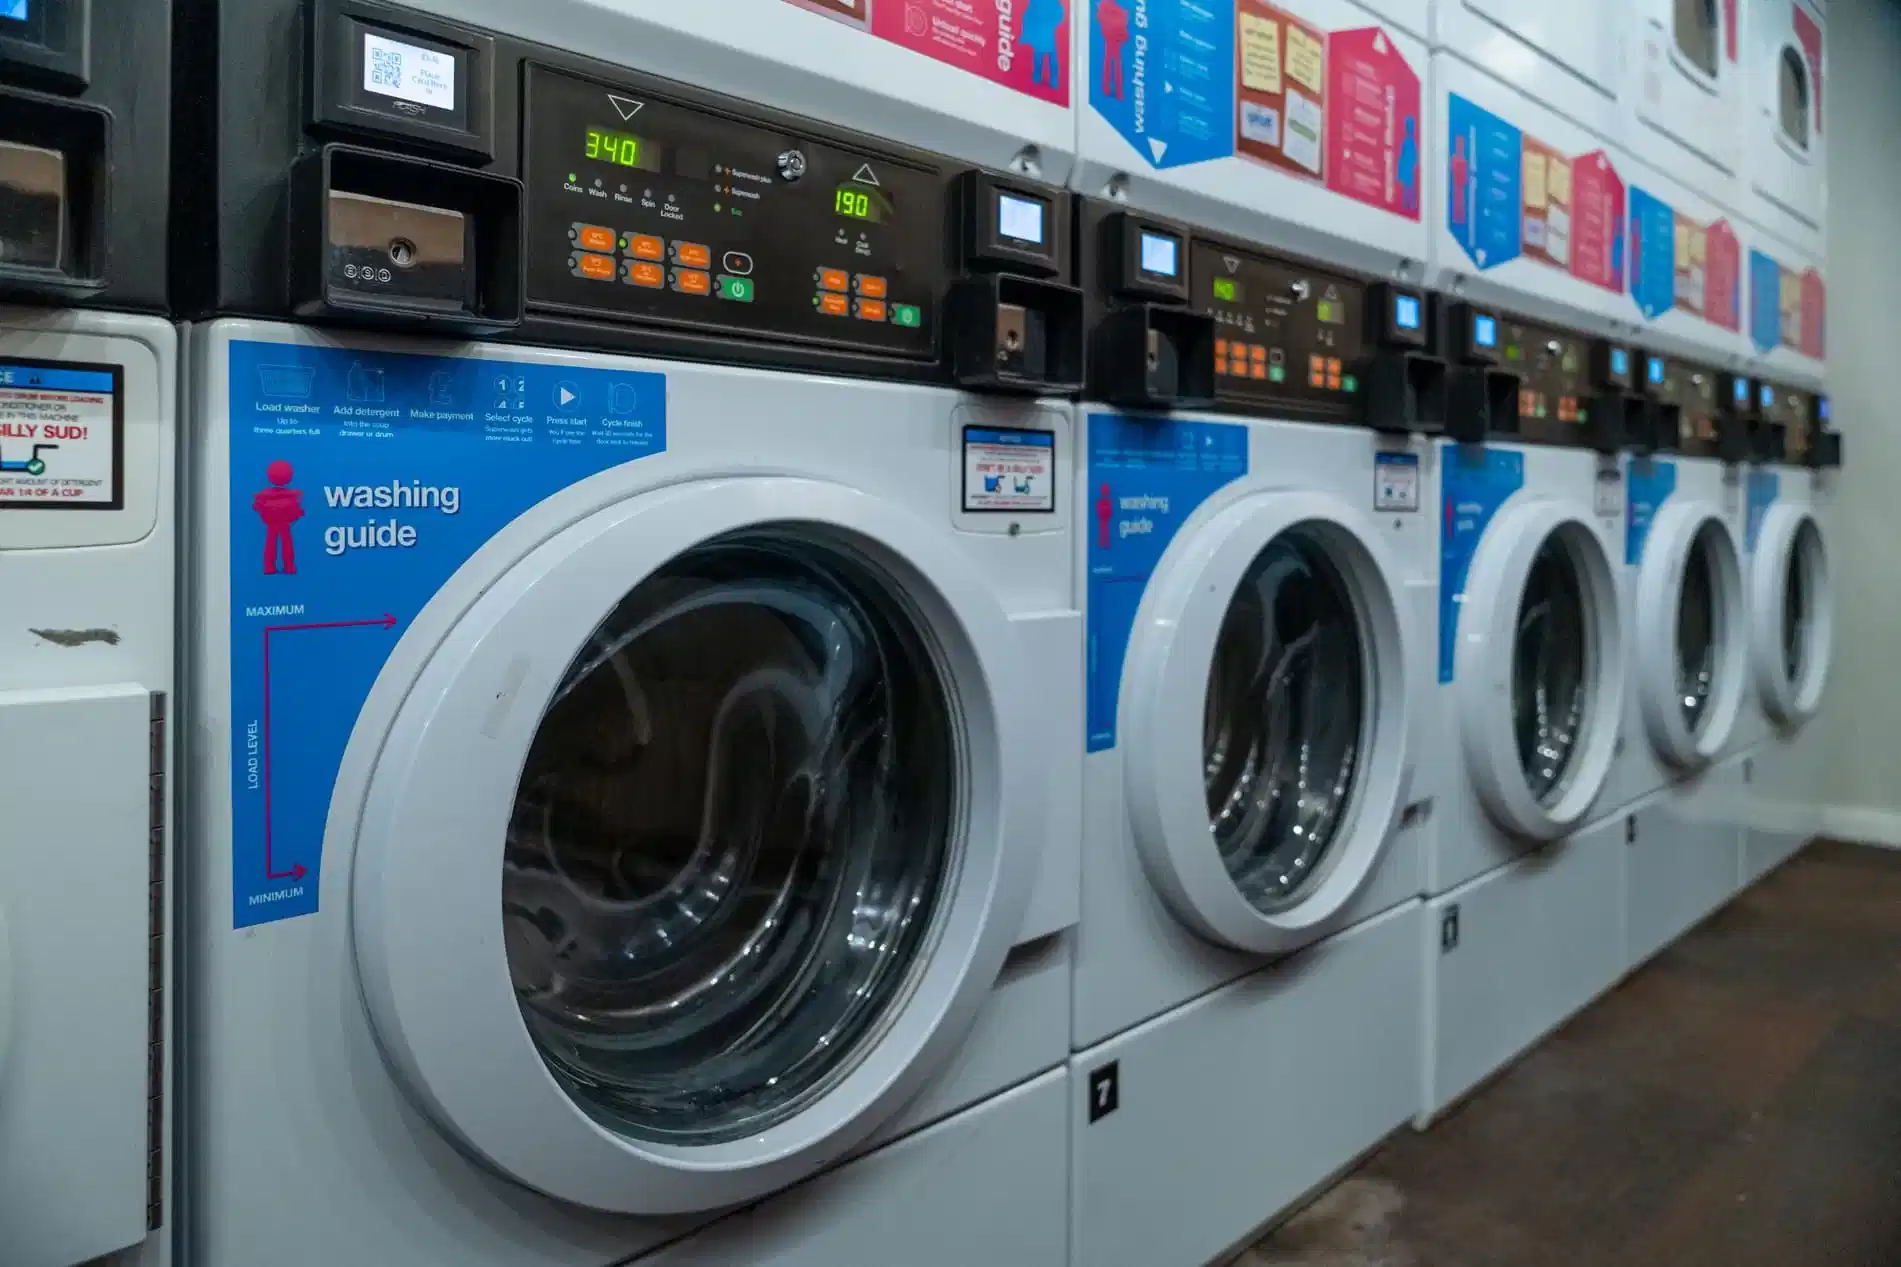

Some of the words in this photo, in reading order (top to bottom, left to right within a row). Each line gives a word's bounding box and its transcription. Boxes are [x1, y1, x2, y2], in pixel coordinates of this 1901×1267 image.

[994, 0, 1015, 72] guide
[1132, 35, 1148, 133] washing
[585, 131, 637, 166] 340
[563, 182, 584, 193] Coins
[588, 187, 608, 199] Wash
[614, 193, 633, 203] Rinse
[641, 198, 656, 209] Spin
[835, 190, 868, 217] 190
[664, 203, 680, 213] Door
[660, 210, 684, 221] Locked
[498, 379, 506, 391] 1
[255, 401, 282, 412] Load
[283, 403, 321, 414] washer
[333, 405, 353, 416] Add
[355, 407, 400, 419] detergent
[410, 408, 435, 419] Make
[436, 410, 474, 422] payment
[485, 412, 511, 423] Select
[512, 414, 533, 425] cycle
[546, 415, 569, 425] Press
[570, 416, 587, 426] start
[601, 417, 622, 428] Cycle
[623, 419, 644, 429] finish
[44, 425, 88, 440] SUD!
[375, 431, 394, 440] drum
[35, 488, 49, 497] OF
[51, 488, 60, 497] A
[62, 489, 84, 498] CUP
[323, 479, 461, 515] washing
[324, 518, 418, 556] guide
[245, 604, 305, 617] MAXIMUM
[247, 719, 258, 756] LEVEL
[247, 758, 259, 790] LOAD
[249, 886, 304, 906] MINIMUM
[1096, 1078, 1112, 1107] 7
